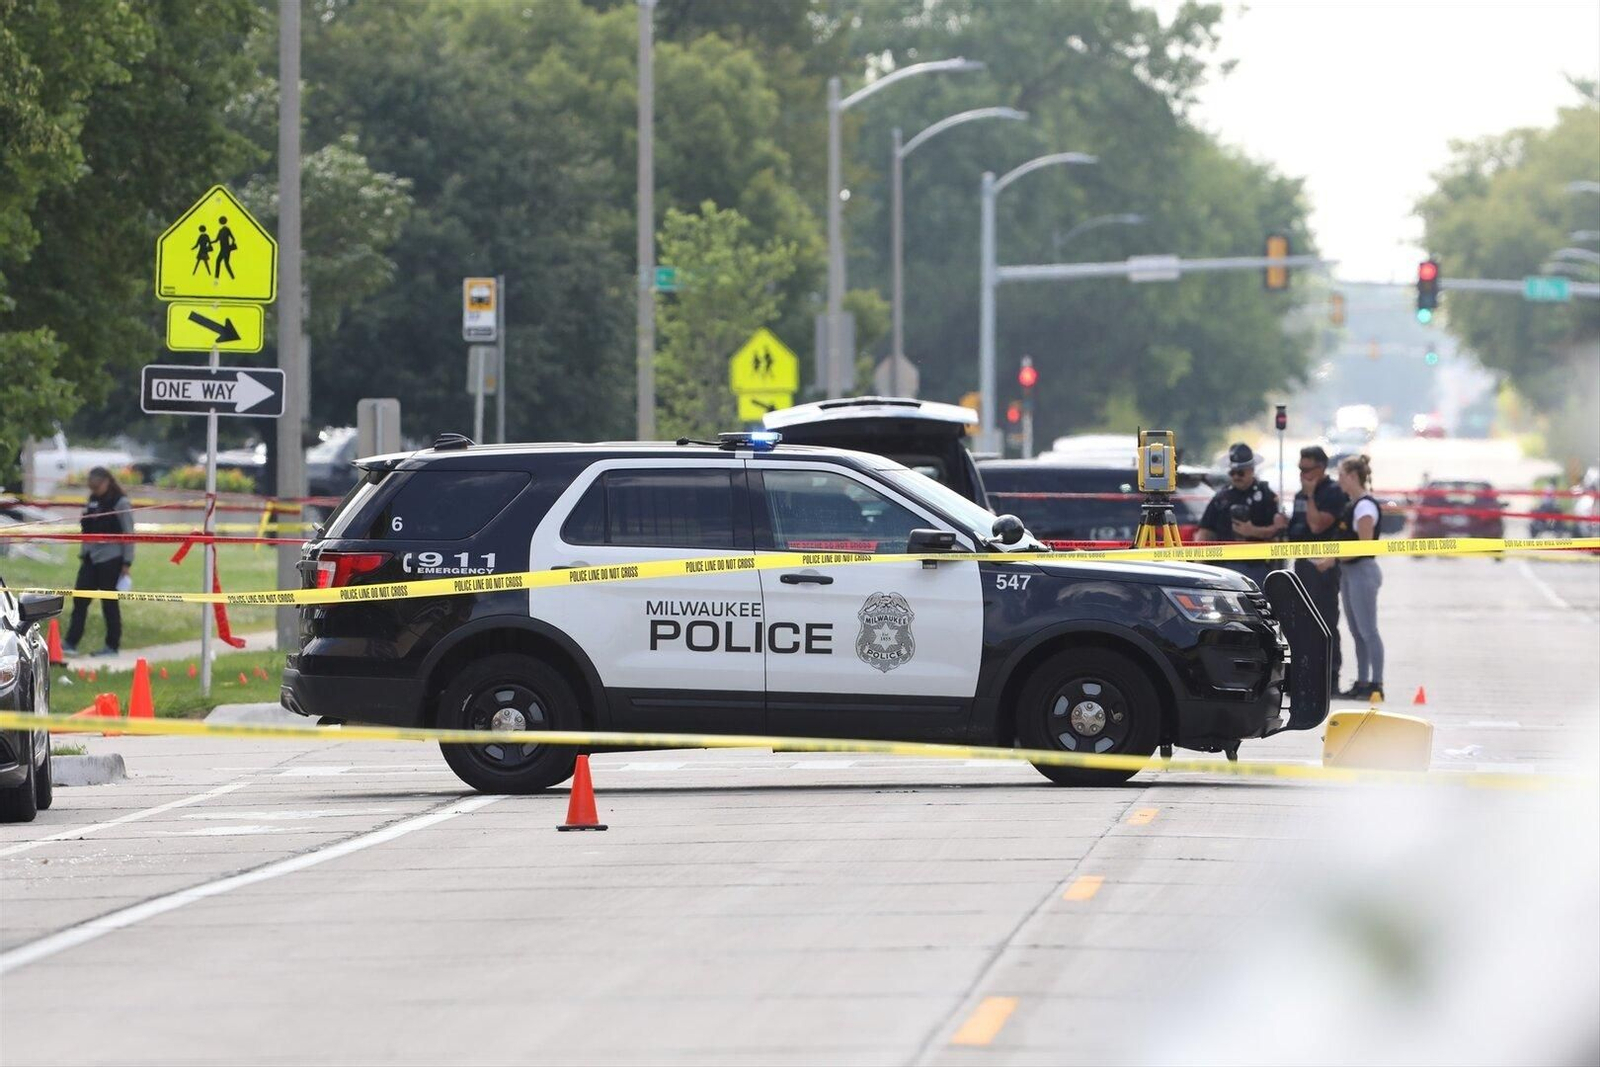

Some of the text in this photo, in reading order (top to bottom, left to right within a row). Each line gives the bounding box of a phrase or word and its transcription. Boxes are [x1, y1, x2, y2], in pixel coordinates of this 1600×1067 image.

[156, 381, 236, 400] ONE WAY
[391, 516, 403, 532] 6
[418, 551, 496, 568] 911
[686, 558, 755, 572] POLICE LINE DO NOT CROSS
[802, 555, 820, 564] POLICE
[822, 555, 833, 564] LINE
[834, 555, 842, 563] DO
[417, 567, 494, 575] EMERGENCY
[570, 566, 638, 582] POLICE LINE DO NOT CROSS
[454, 576, 522, 592] POLICE LINE DO NOT CROSS
[996, 574, 1032, 590] 547
[340, 586, 408, 600] POLICE LINE DO NOT CROSS
[646, 600, 762, 618] MILWAUKEE
[866, 616, 906, 624] MILWAUKEE
[650, 620, 834, 654] POLICE
[867, 649, 903, 660] POLICE
